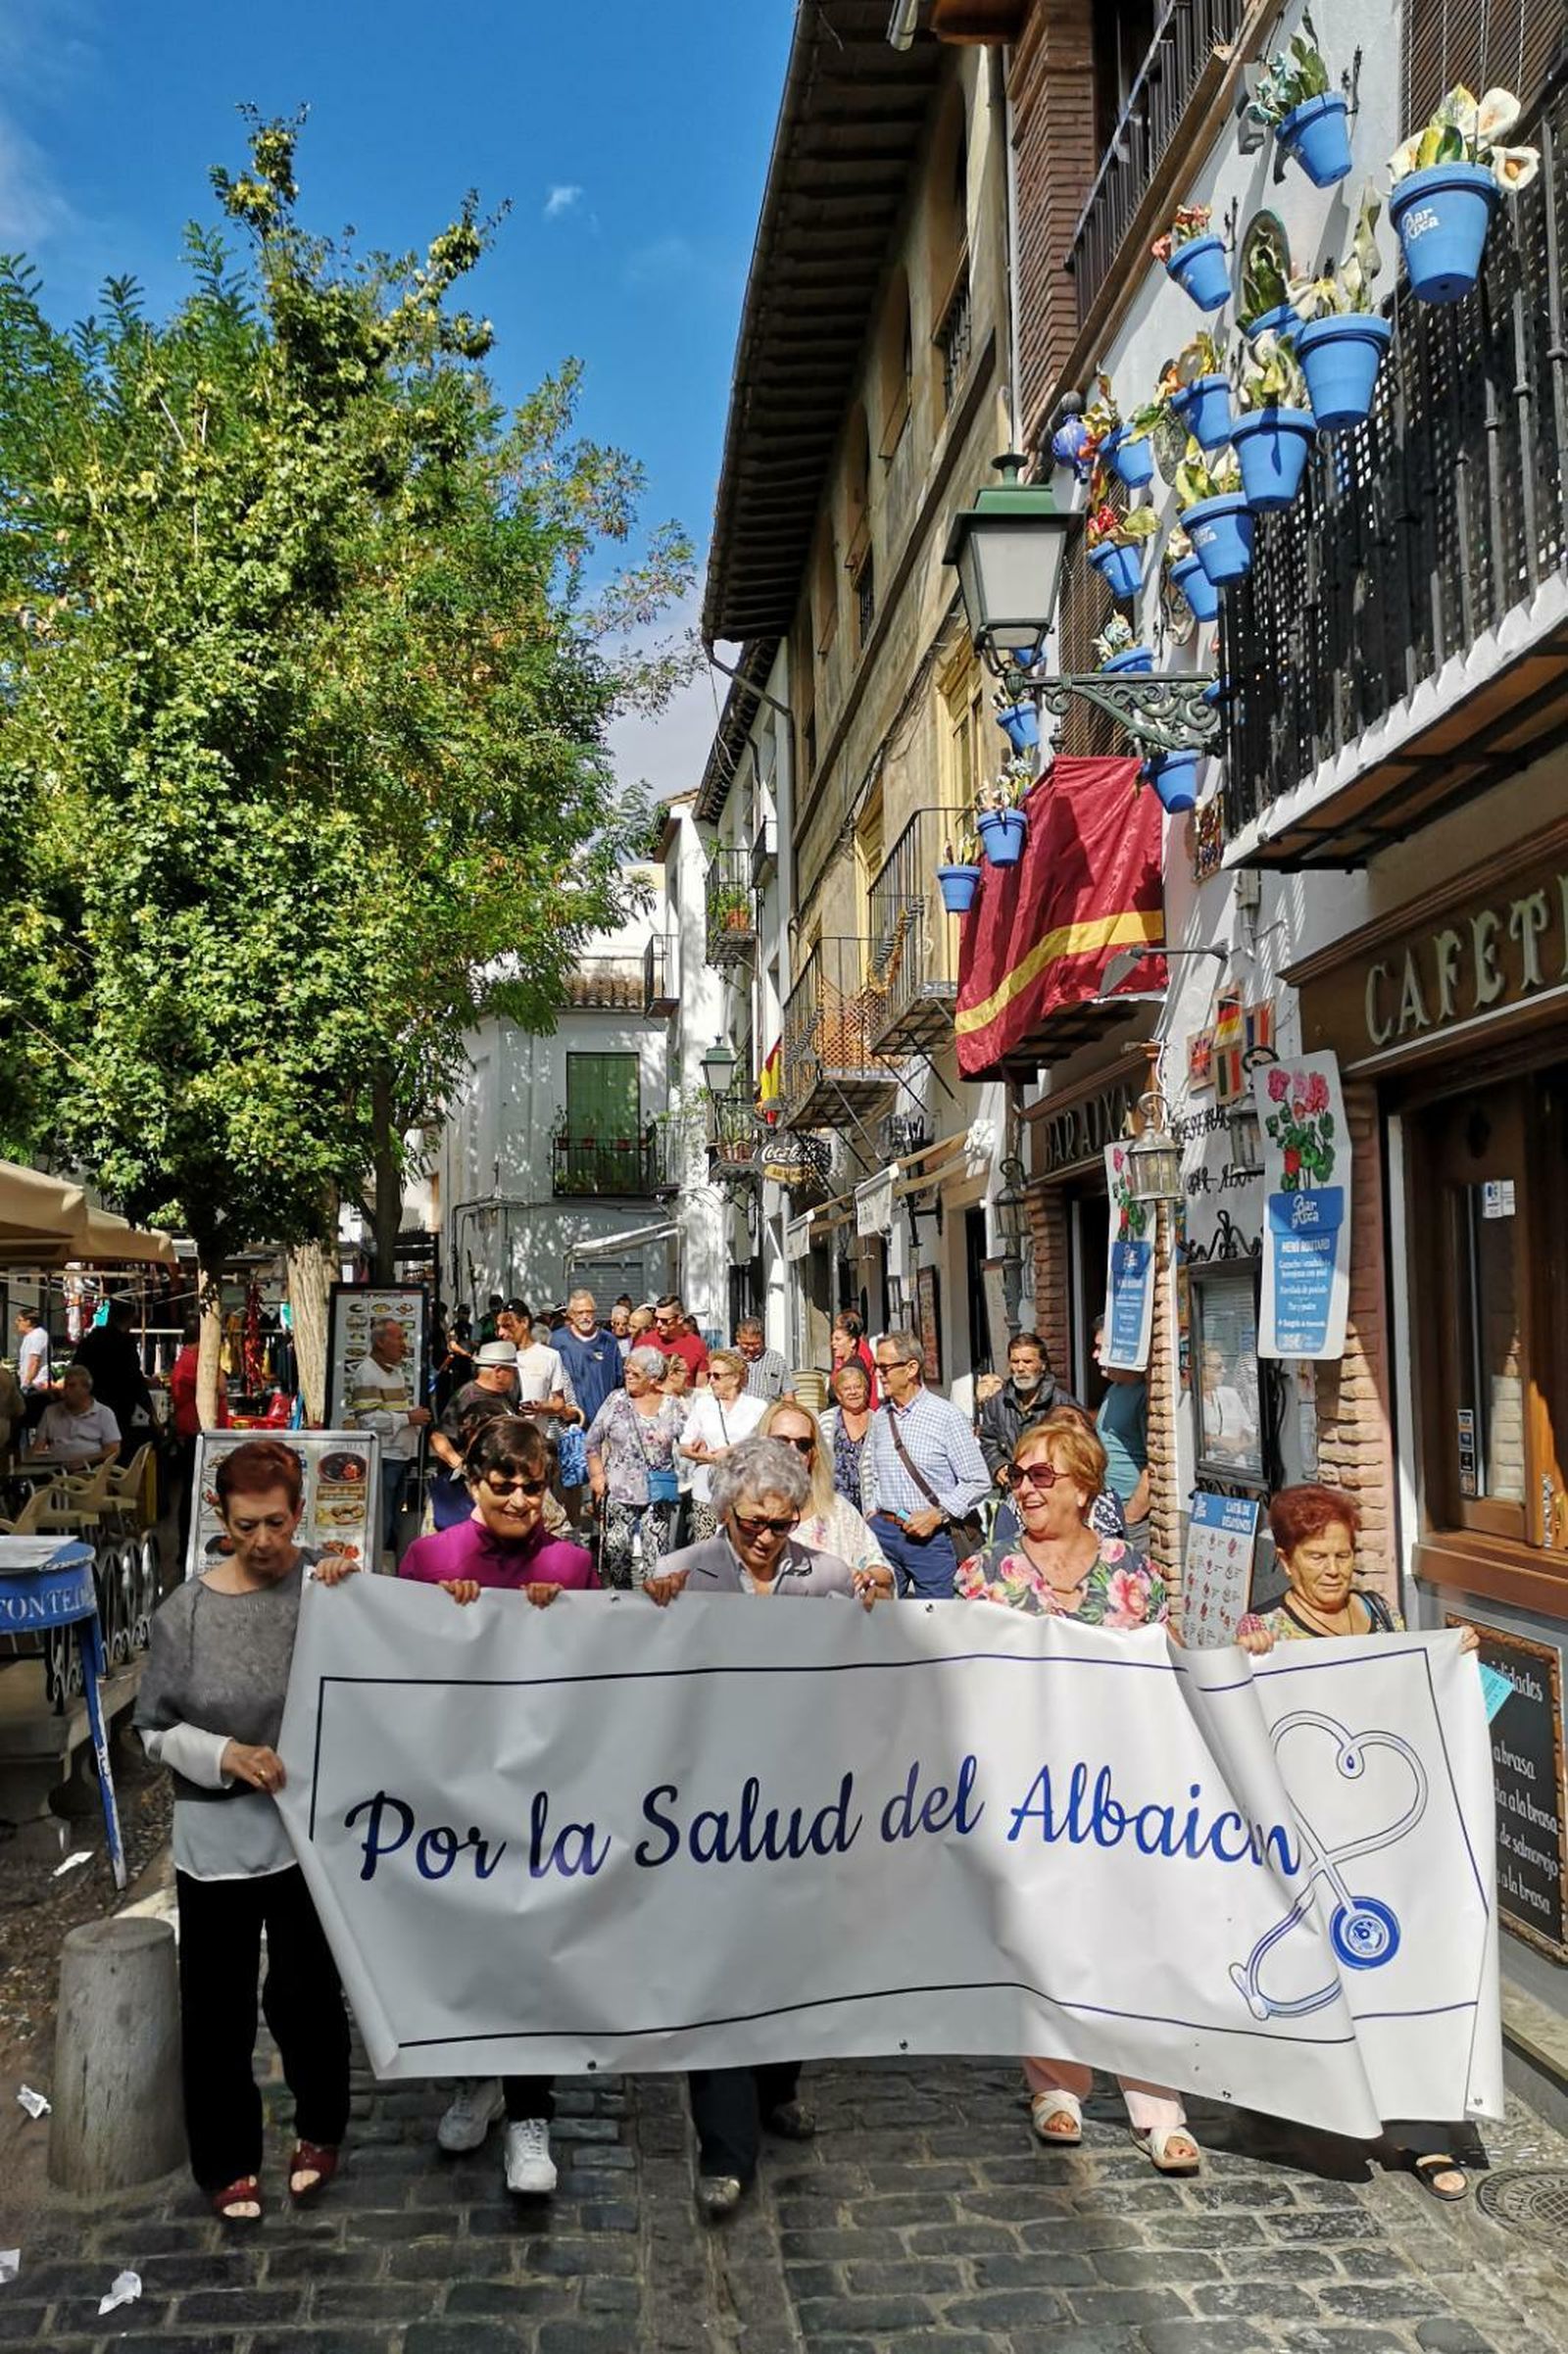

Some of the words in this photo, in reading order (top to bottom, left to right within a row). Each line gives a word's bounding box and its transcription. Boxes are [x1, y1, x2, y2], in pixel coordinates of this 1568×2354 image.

[1500, 1740, 1537, 1780] brasa
[344, 1790, 507, 1881] Por
[528, 1790, 612, 1879] la
[634, 1771, 863, 1868] Salud
[882, 1754, 985, 1843] del
[1527, 1791, 1559, 1837] brasa
[1518, 1871, 1552, 1915] brasa
